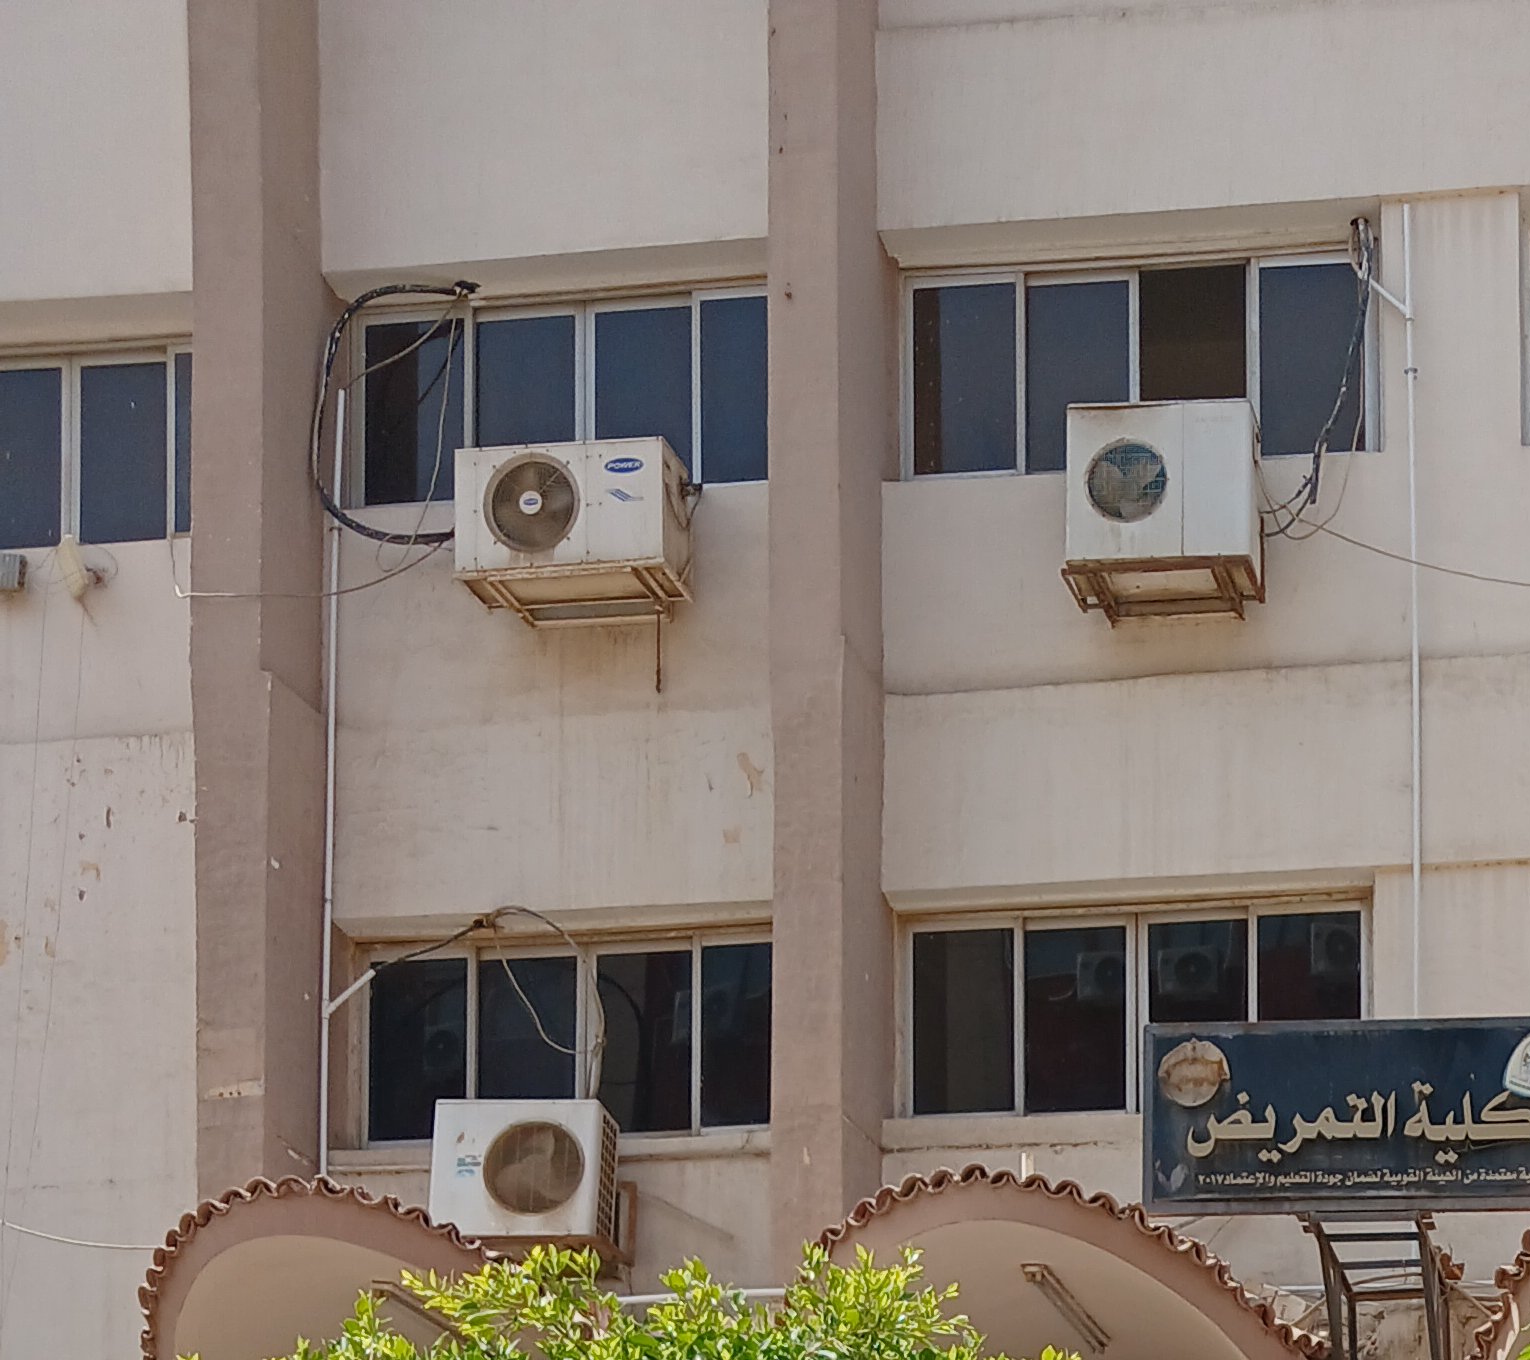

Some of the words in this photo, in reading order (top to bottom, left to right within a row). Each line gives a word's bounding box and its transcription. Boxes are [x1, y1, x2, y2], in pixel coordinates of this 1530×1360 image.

[1186, 1089, 1397, 1164] التمريض
[1276, 1170, 1315, 1187] التعليم
[1316, 1170, 1343, 1185] جودة
[1345, 1169, 1381, 1185] لضمان
[1383, 1168, 1424, 1185] القومية
[1463, 1168, 1478, 1184] من
[1480, 1168, 1517, 1181] معتمدة
